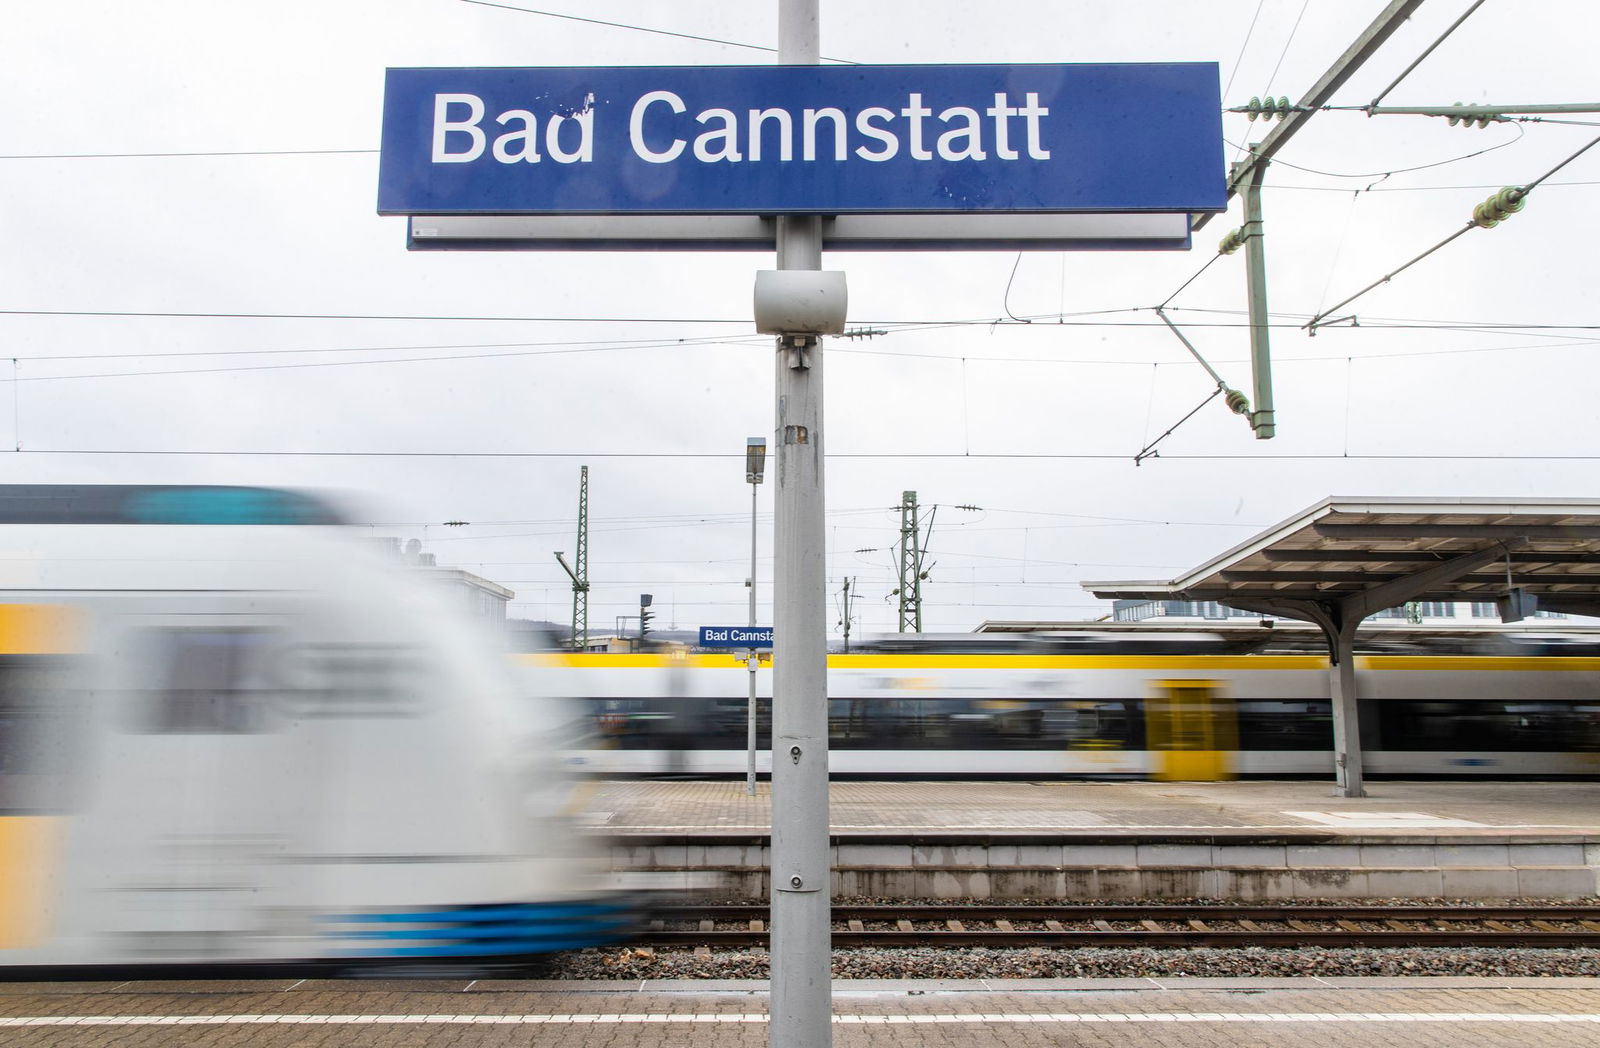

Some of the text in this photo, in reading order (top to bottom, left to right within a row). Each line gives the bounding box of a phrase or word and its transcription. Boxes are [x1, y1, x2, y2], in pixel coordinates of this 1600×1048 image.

[432, 91, 1051, 164] Bad Cannstatt
[705, 629, 727, 641] Bad
